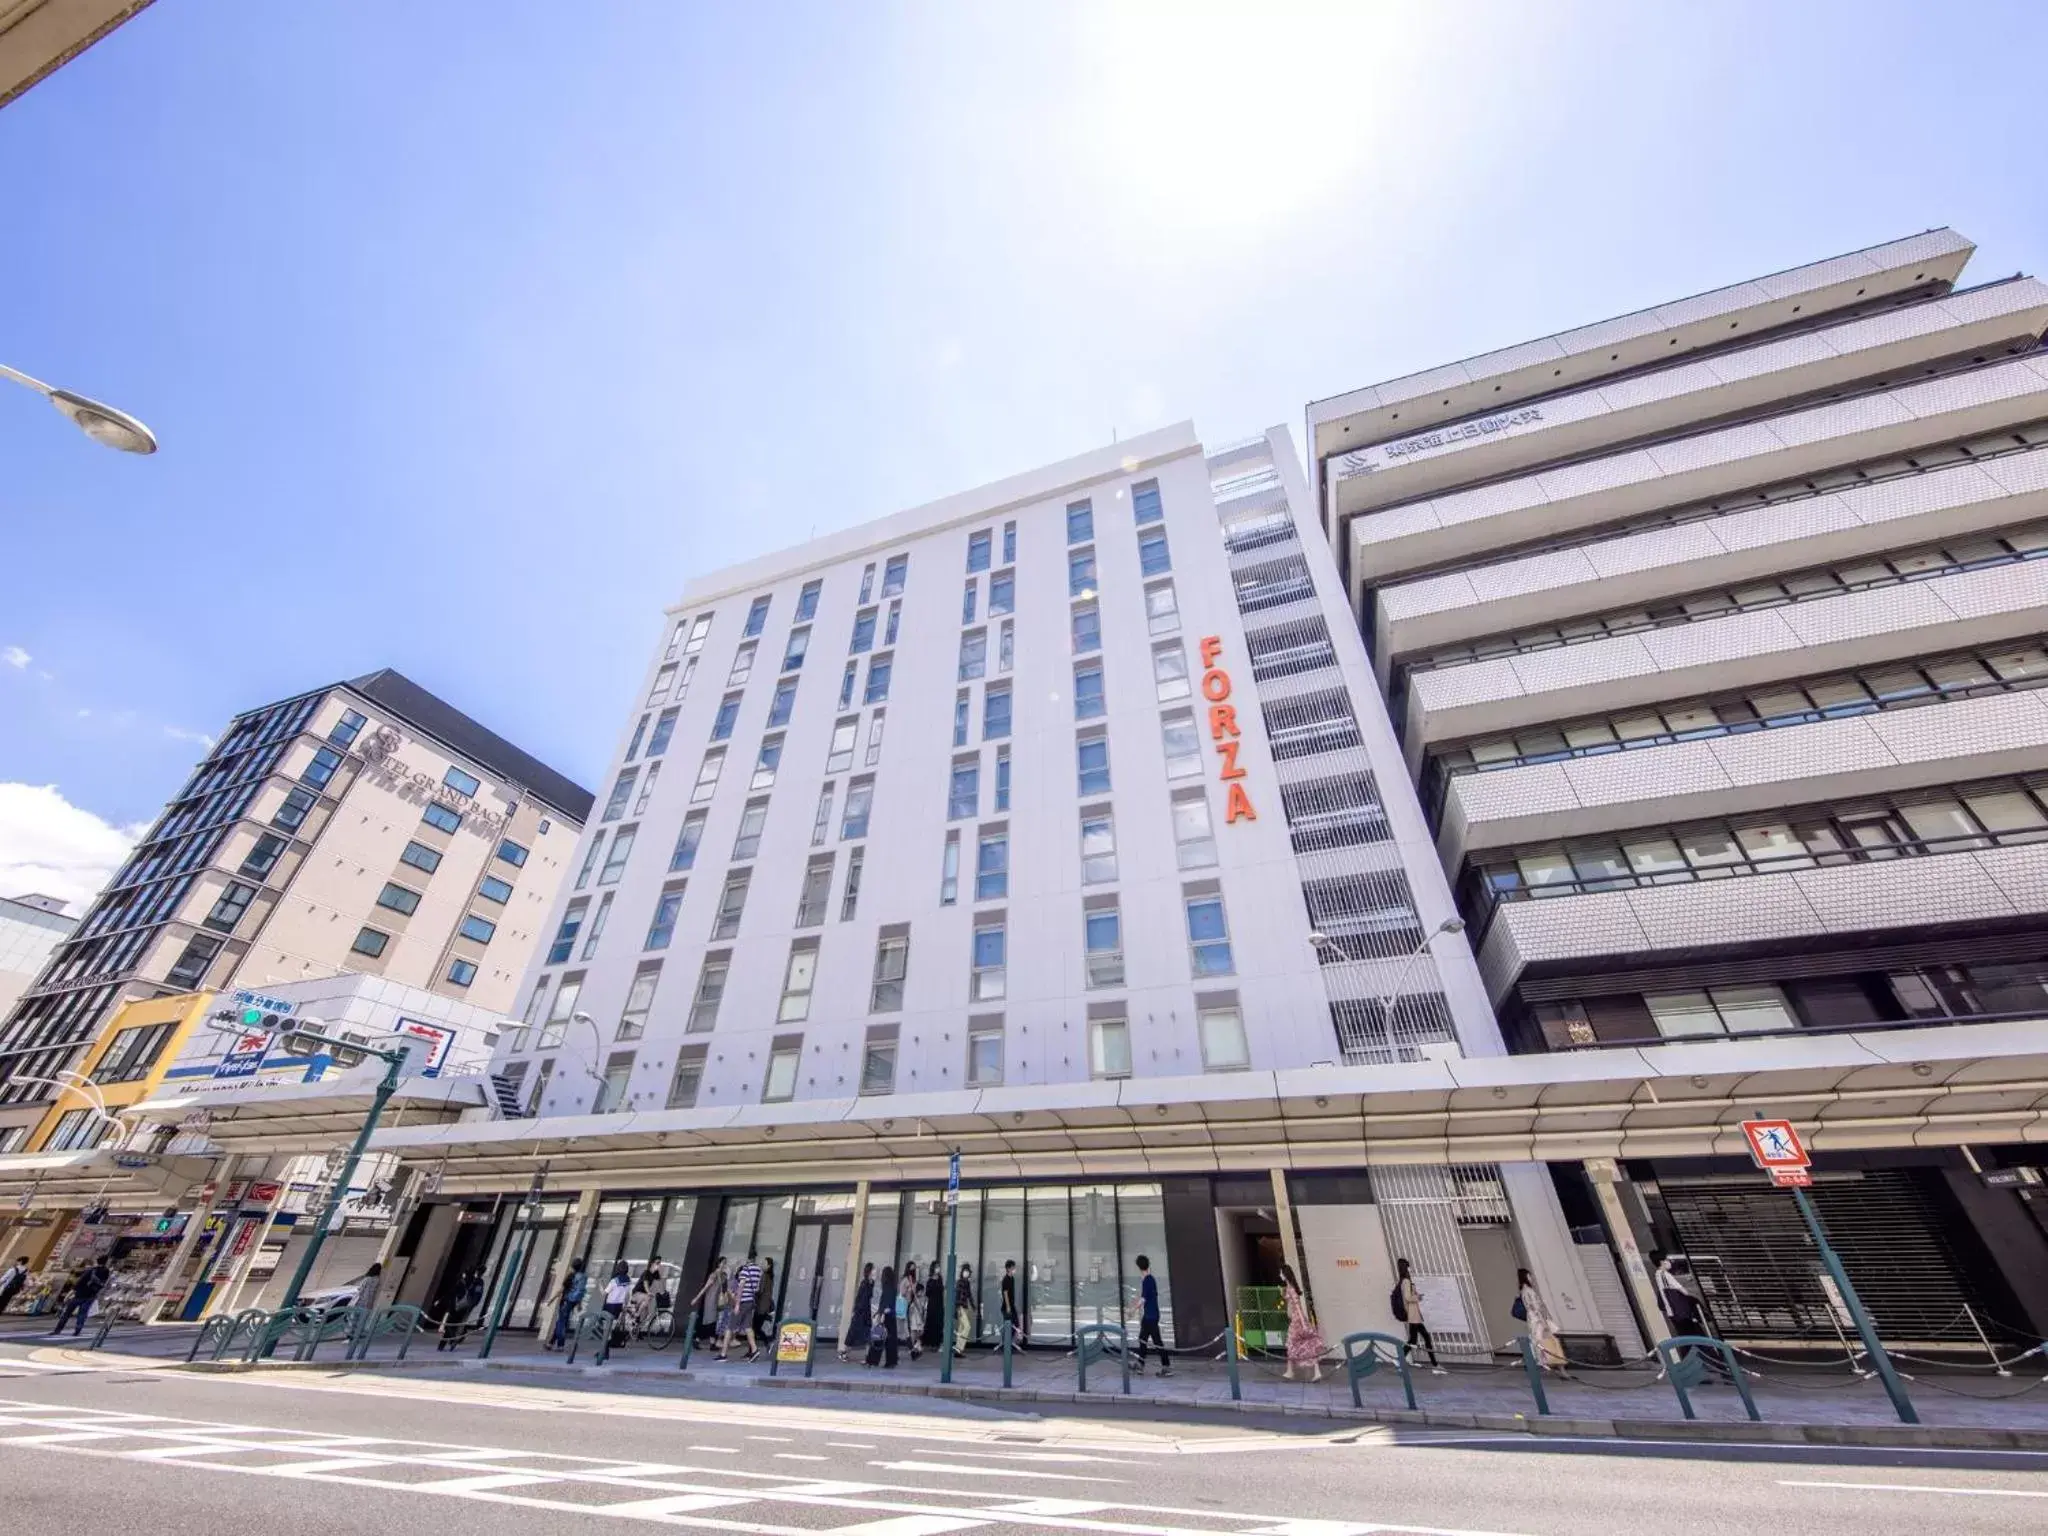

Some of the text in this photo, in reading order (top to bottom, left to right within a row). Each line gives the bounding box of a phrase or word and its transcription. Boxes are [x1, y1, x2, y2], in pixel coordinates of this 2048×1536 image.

[1200, 635, 1257, 825] FORZA
[413, 772, 469, 806] GRAND
[470, 801, 509, 829] BACH
